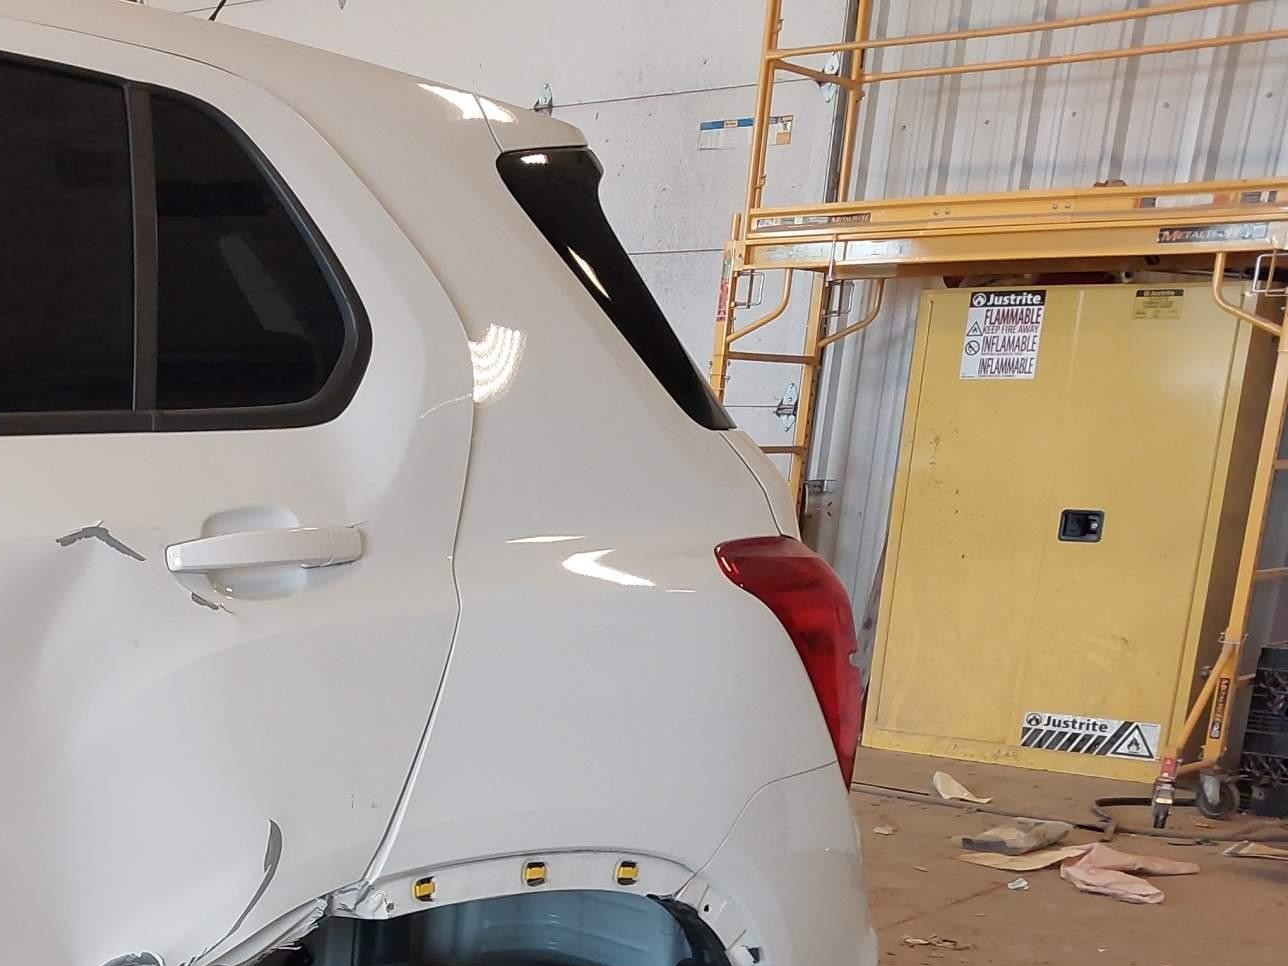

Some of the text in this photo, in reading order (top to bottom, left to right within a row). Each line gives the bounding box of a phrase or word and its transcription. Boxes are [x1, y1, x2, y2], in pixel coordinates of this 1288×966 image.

[987, 292, 1041, 306] Justrite
[985, 308, 1042, 325] FLAMMABLE
[983, 325, 1039, 335] KEEP FIRE AWAY
[981, 335, 1038, 353] INFLAMABLE
[978, 357, 1034, 375] INFLAMMABLE
[1044, 716, 1108, 732] Justrite
